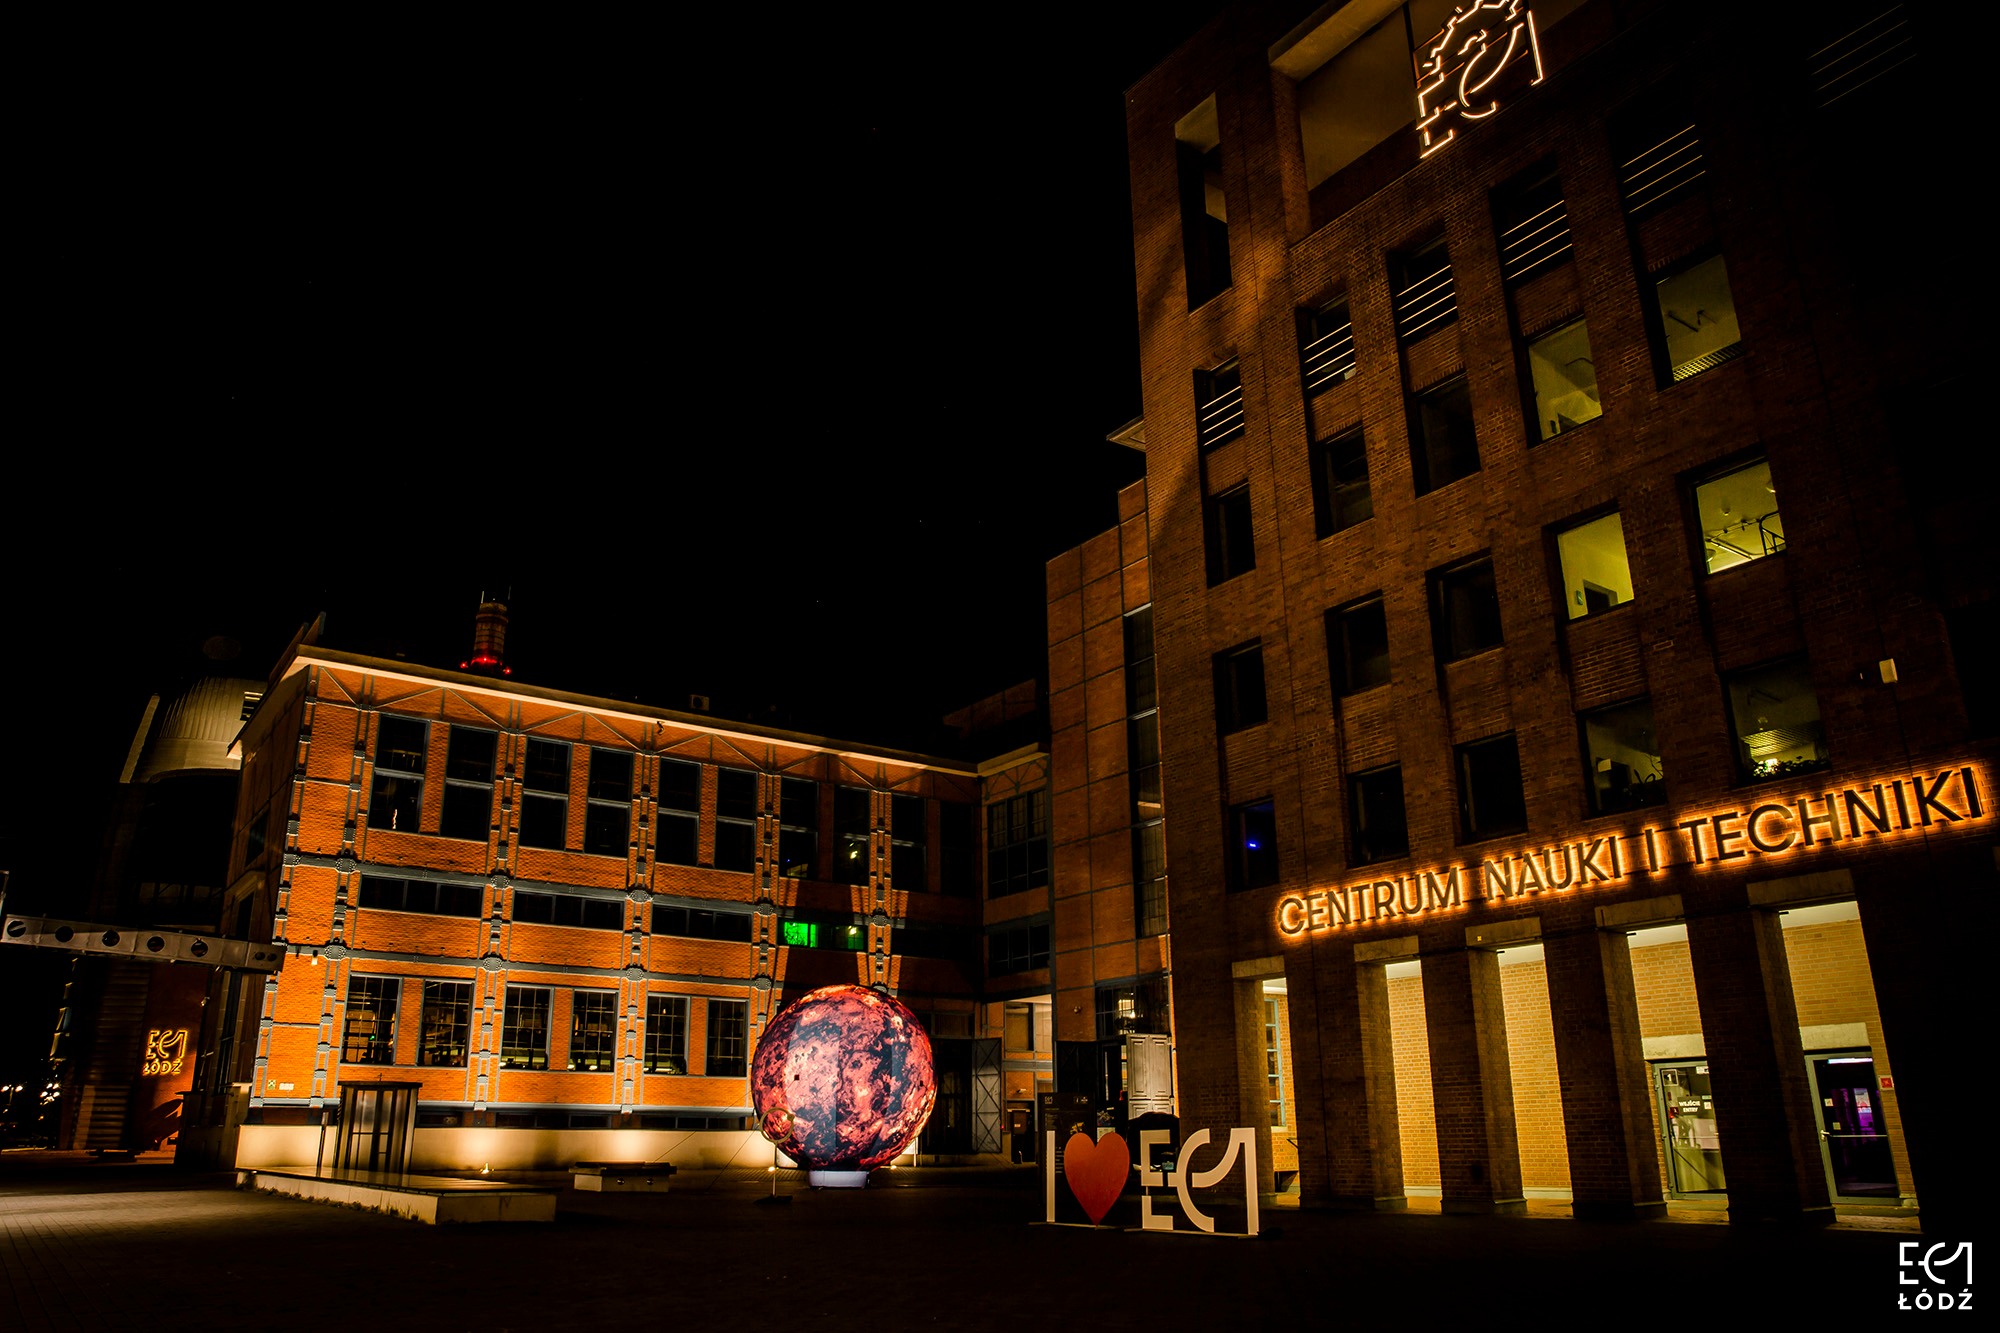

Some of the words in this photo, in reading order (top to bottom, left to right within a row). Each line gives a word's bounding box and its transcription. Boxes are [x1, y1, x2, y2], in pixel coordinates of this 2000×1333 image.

[1277, 867, 1463, 935] CENTRUM
[1484, 835, 1622, 901] NAUKI
[1644, 828, 1659, 872] I
[1679, 766, 1984, 865] TECHNIKI
[142, 1058, 183, 1076] ŁÓDŹ
[146, 1030, 188, 1059] EC1
[1046, 1130, 1056, 1222] I
[1140, 1127, 1259, 1236] EC1
